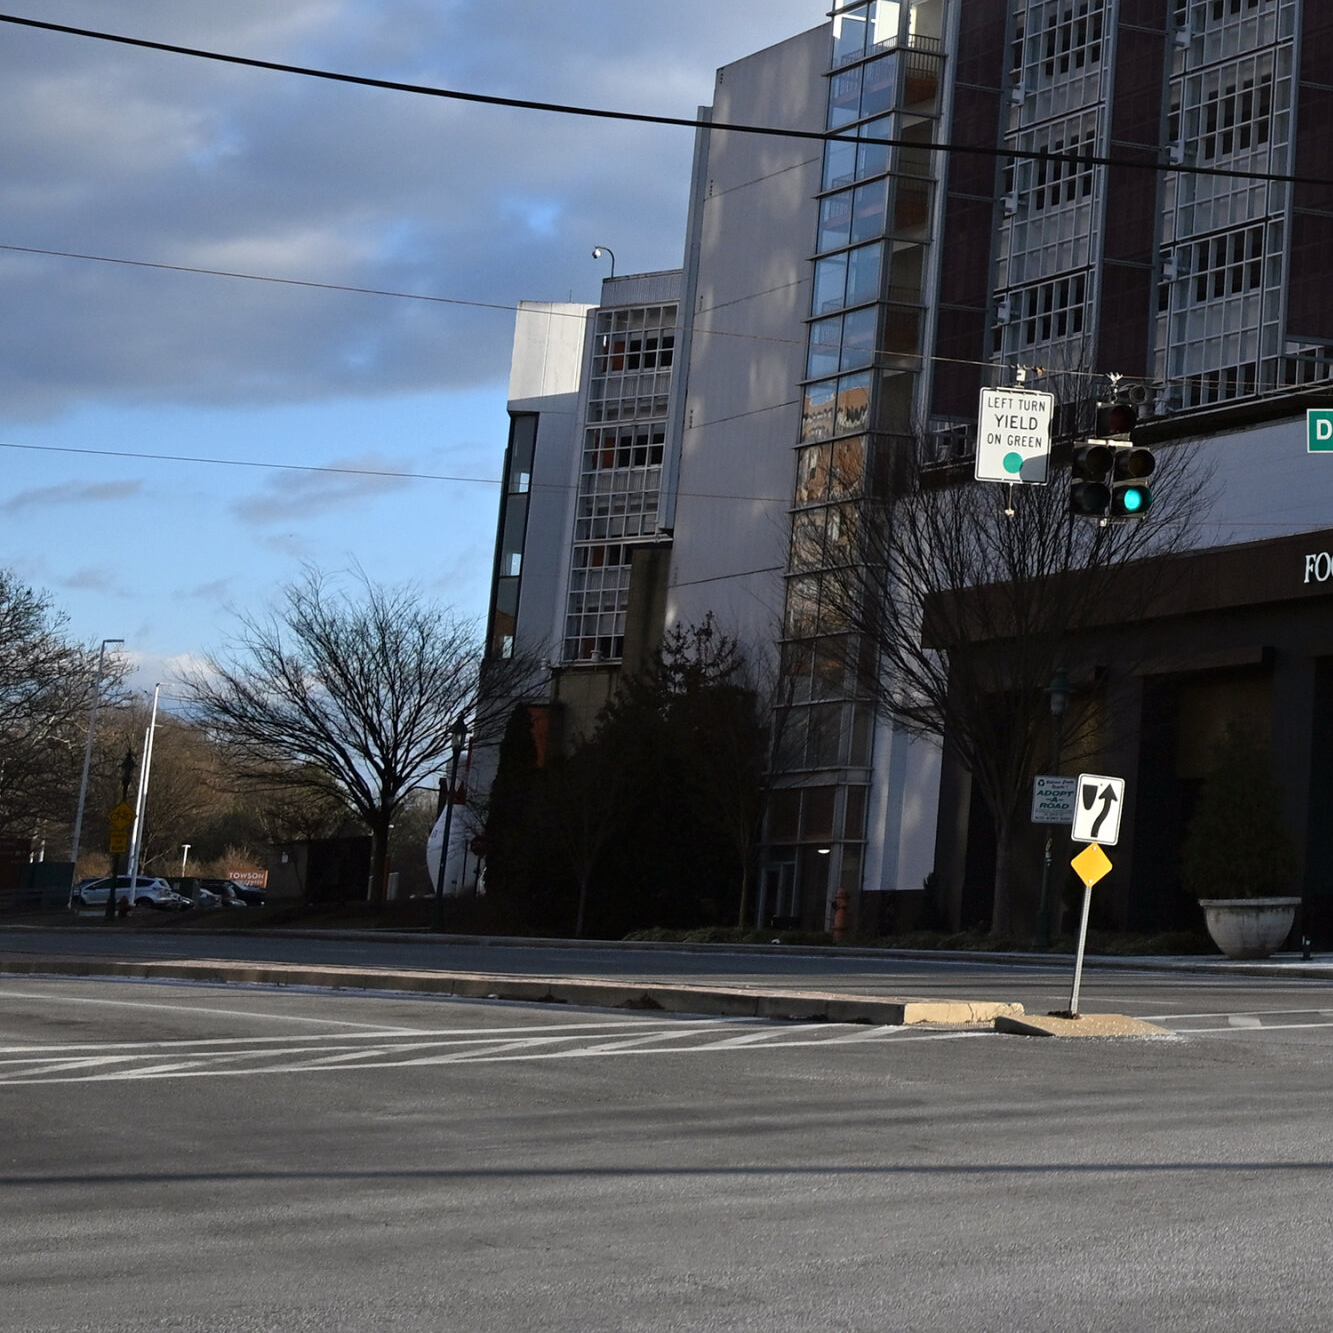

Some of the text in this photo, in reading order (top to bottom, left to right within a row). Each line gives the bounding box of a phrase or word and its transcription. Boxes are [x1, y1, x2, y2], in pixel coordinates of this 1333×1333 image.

[988, 397, 1045, 412] LEFT TURN
[995, 414, 1037, 430] YIELD
[987, 433, 1042, 448] ON GREEN
[1037, 790, 1074, 798] ADOPT
